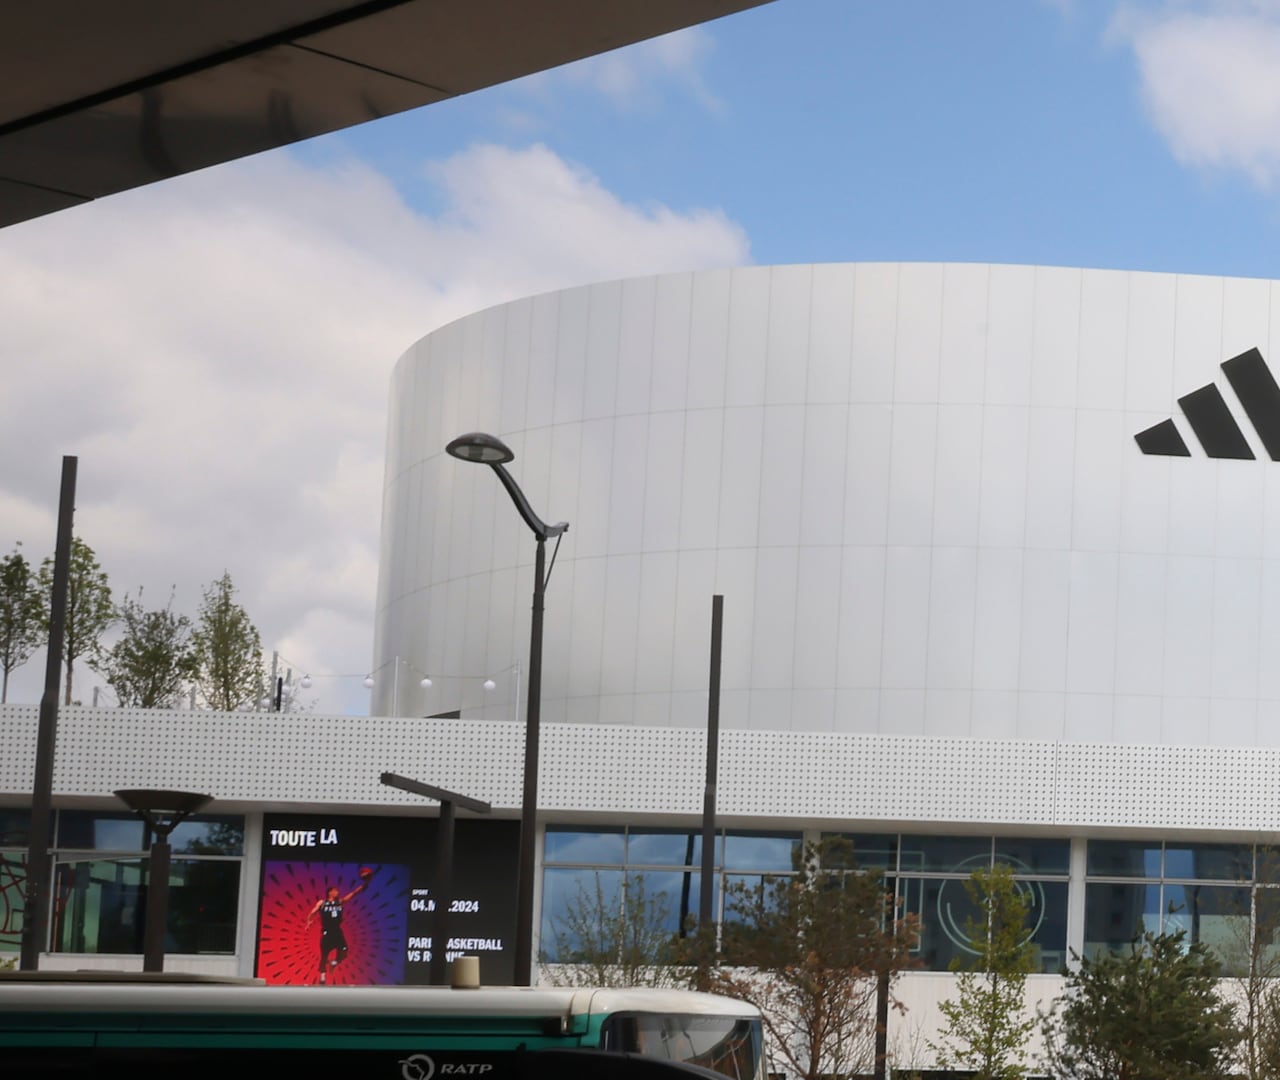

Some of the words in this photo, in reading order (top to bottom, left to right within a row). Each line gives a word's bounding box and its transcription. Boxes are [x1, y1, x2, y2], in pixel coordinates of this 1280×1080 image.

[270, 829, 316, 846] TOUTE
[320, 829, 338, 844] LA
[446, 938, 503, 950] ASKETBALL
[408, 951, 420, 962] VS
[440, 1063, 493, 1074] RATP
